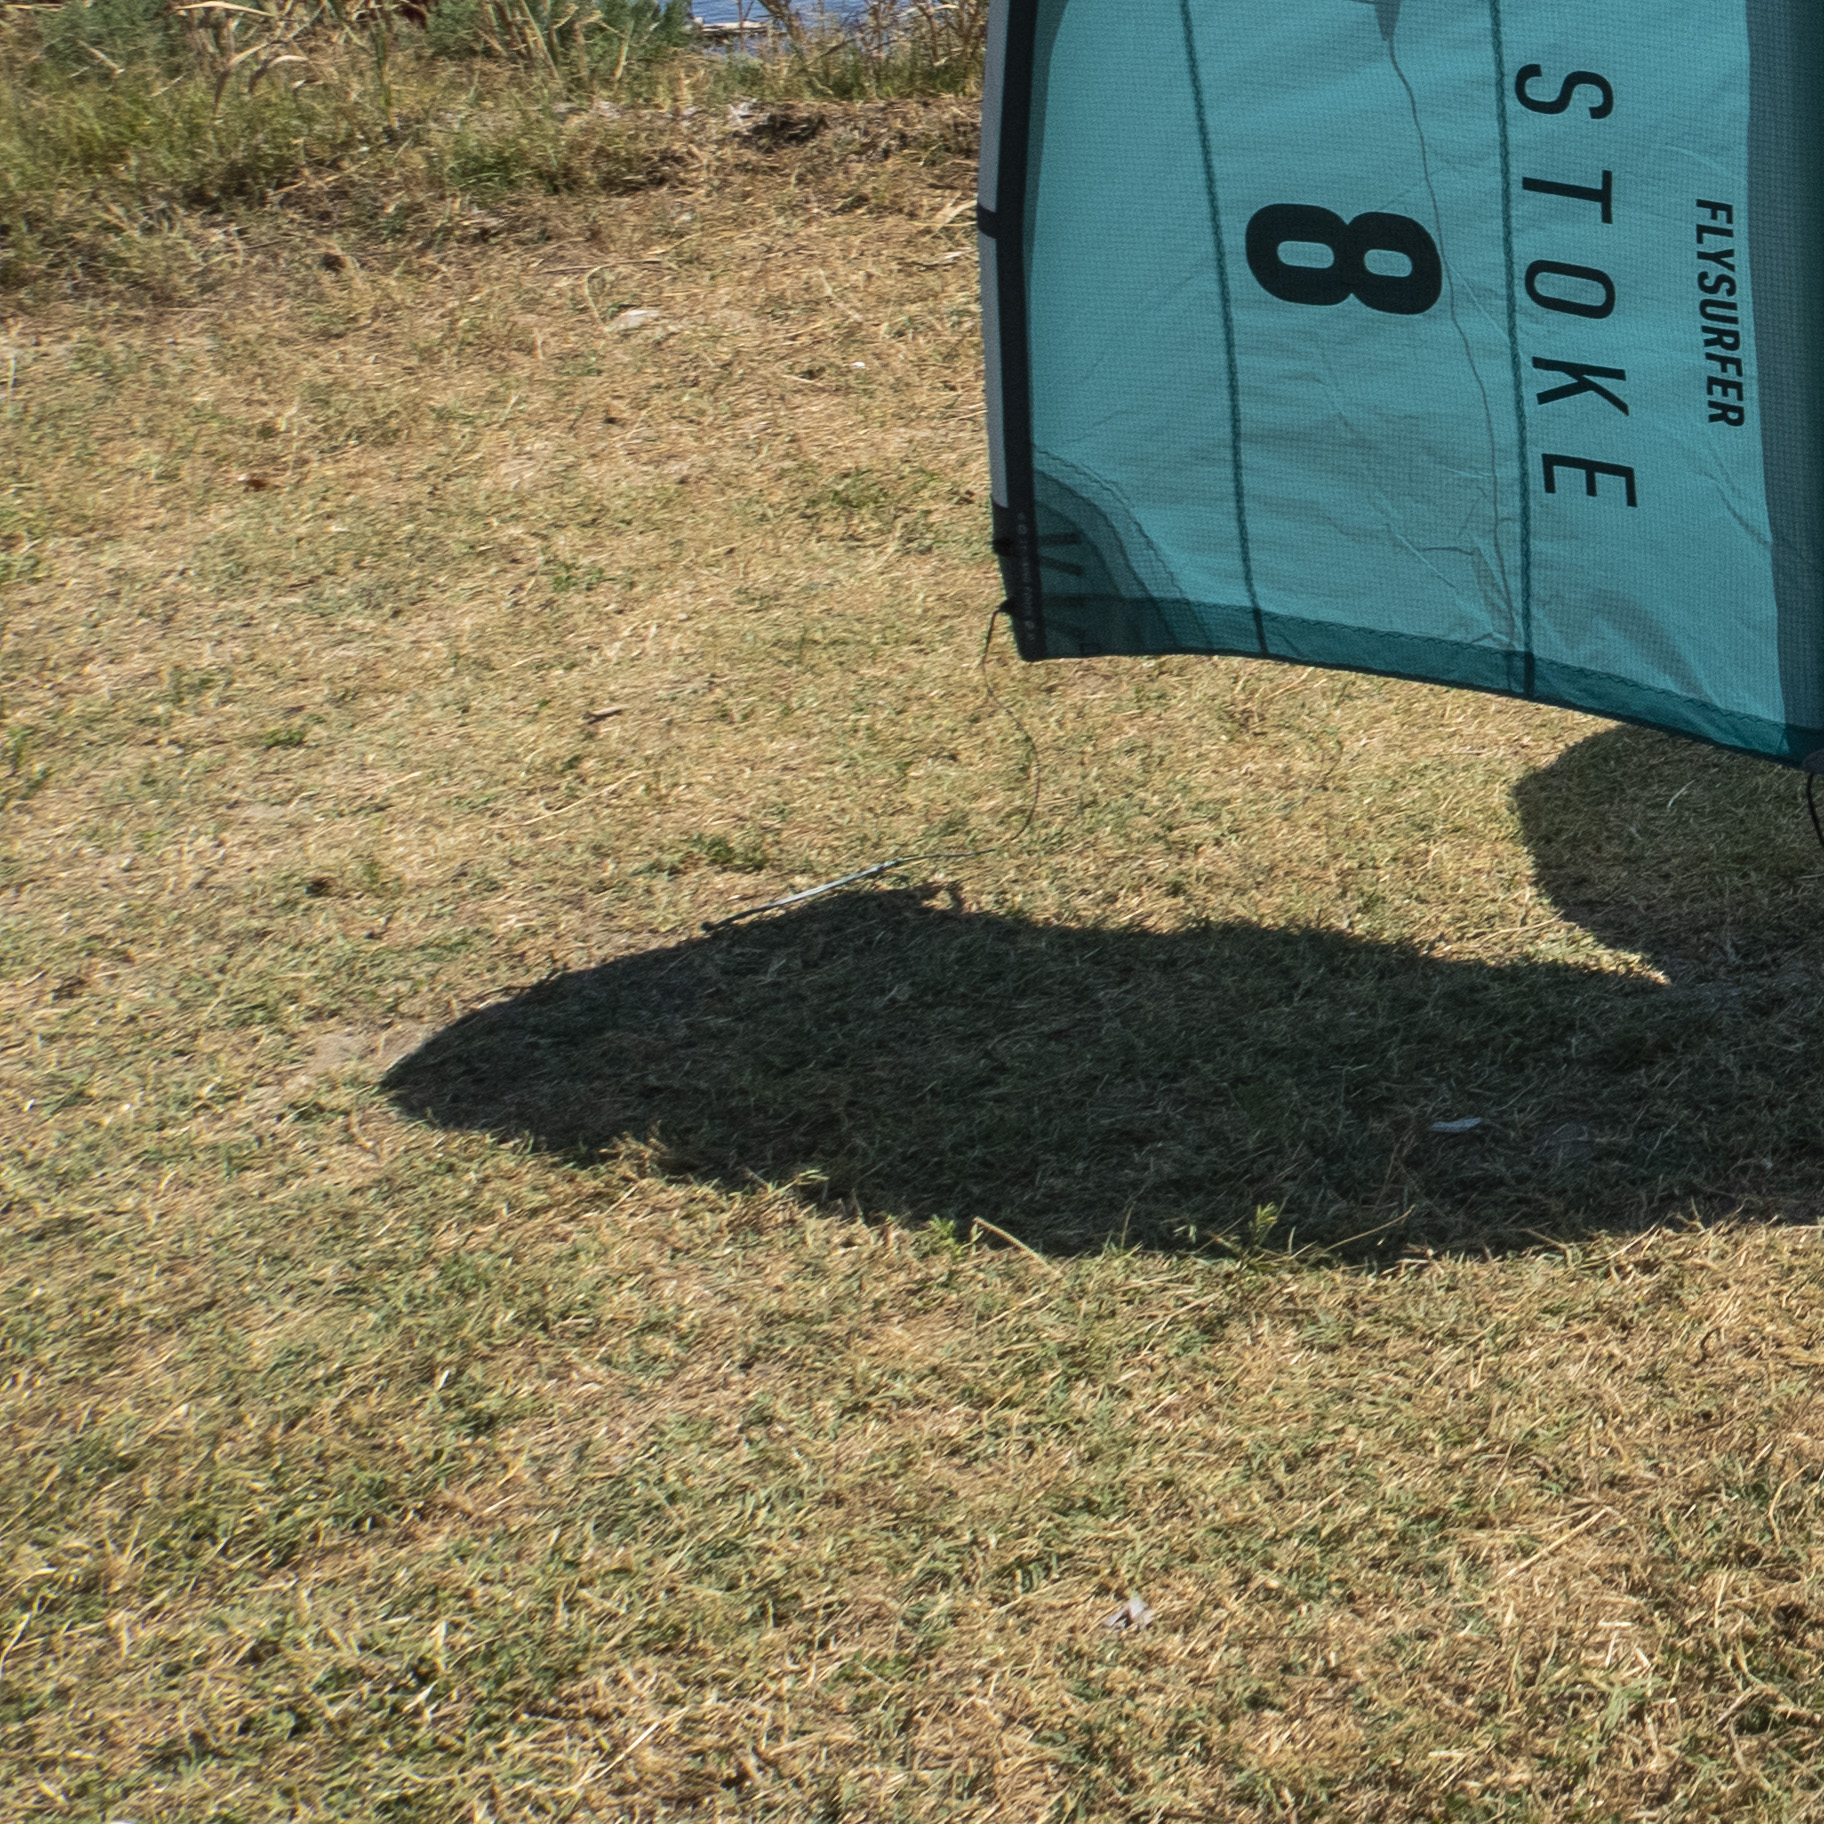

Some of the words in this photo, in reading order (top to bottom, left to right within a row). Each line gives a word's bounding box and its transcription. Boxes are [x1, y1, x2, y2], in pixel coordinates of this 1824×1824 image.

[1244, 202, 1443, 316] 8
[1514, 63, 1639, 509] STOKE
[1694, 198, 1746, 428] FLYSURFER
